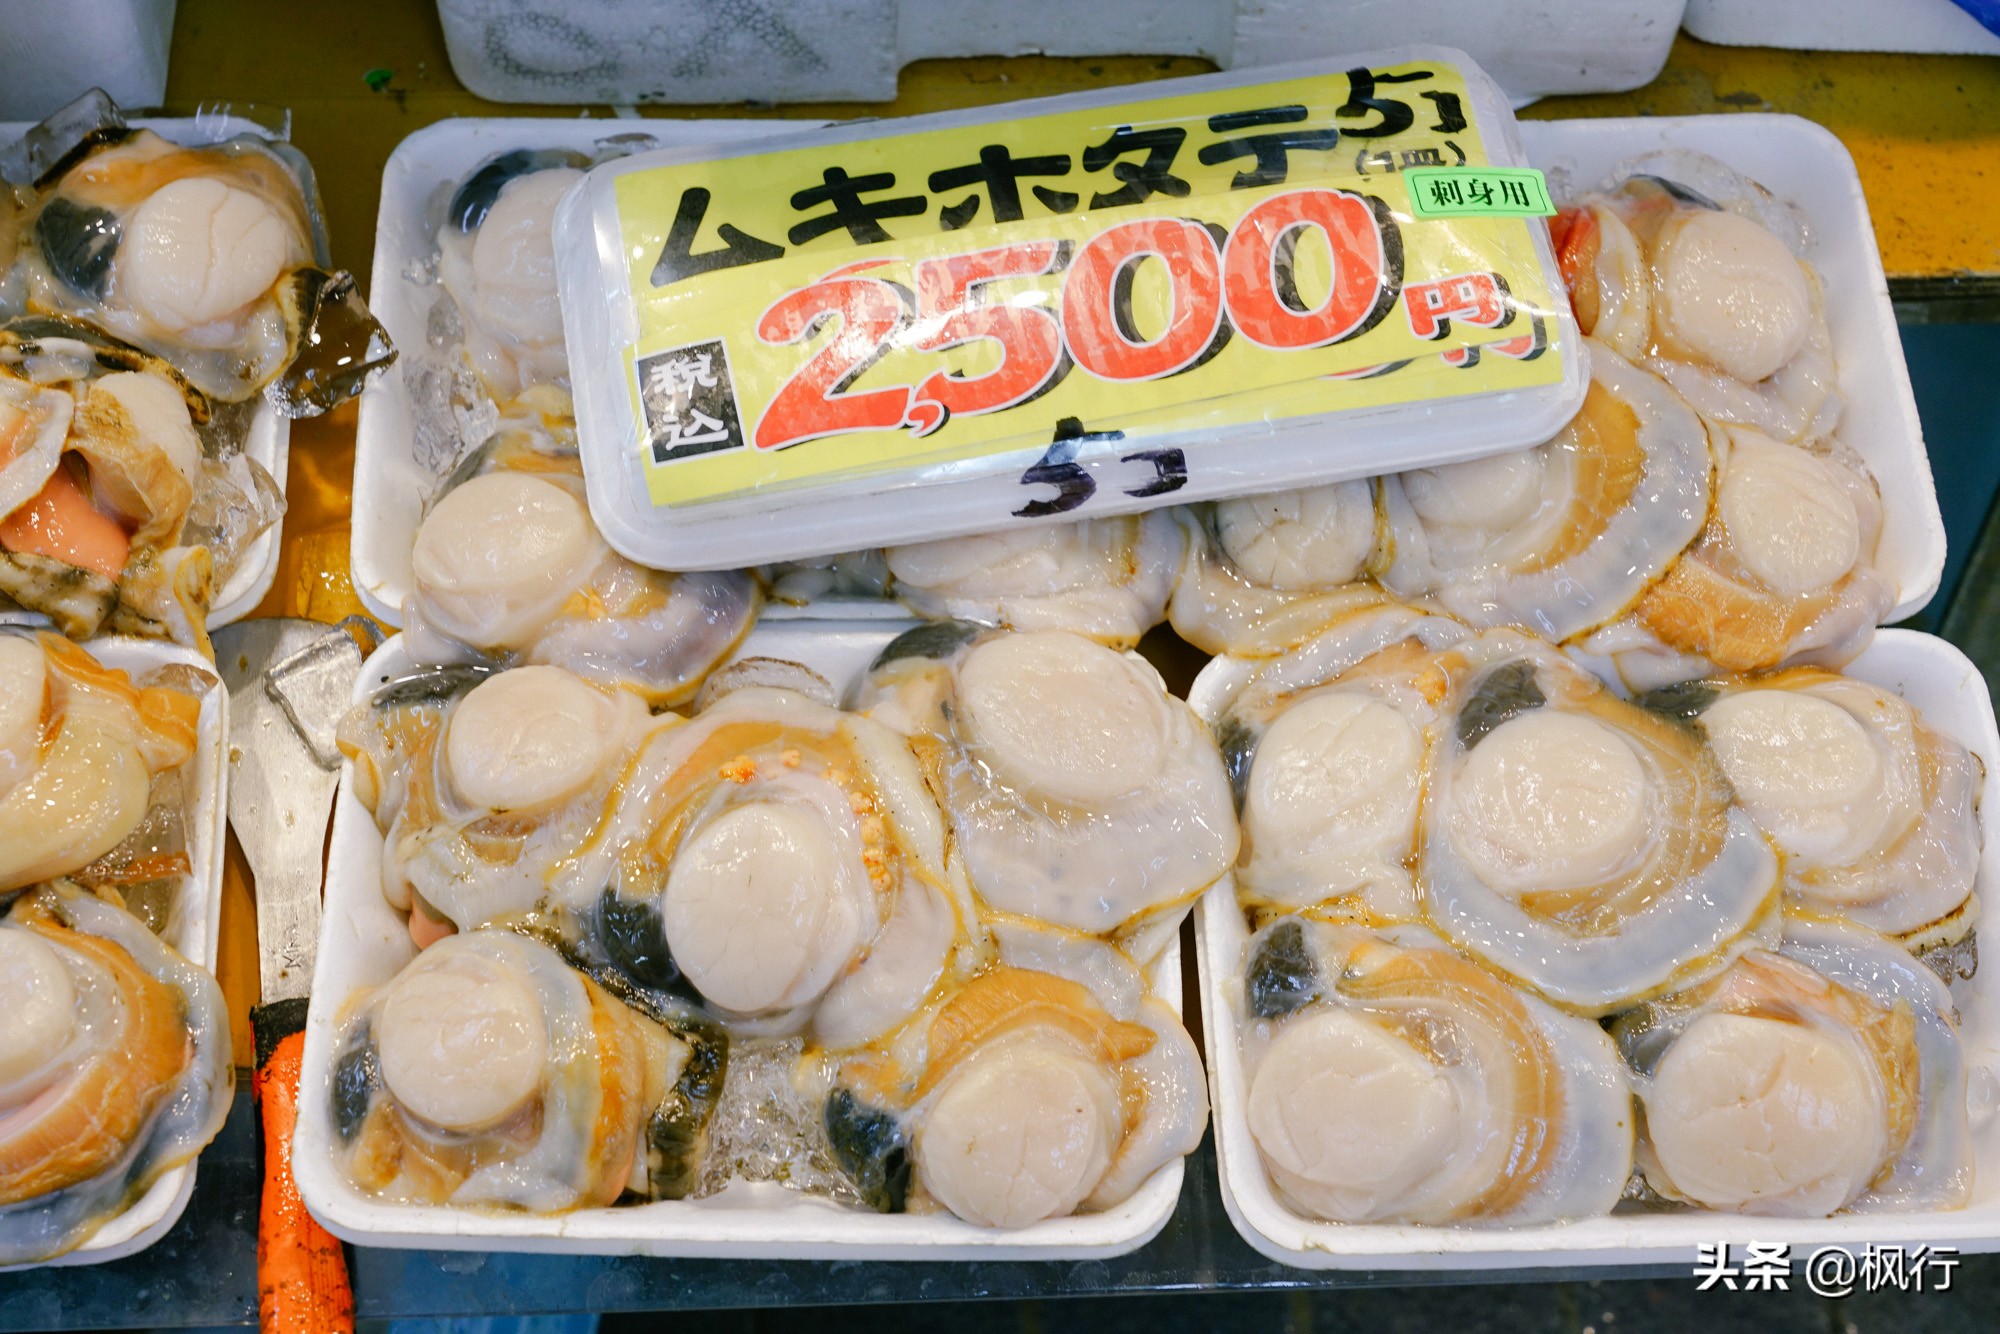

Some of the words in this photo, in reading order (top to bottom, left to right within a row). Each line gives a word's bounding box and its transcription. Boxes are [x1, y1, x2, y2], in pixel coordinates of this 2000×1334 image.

[650, 104, 1339, 288] ムキホタテ
[1428, 178, 1531, 207] 刺身用
[650, 352, 729, 451] 税込
